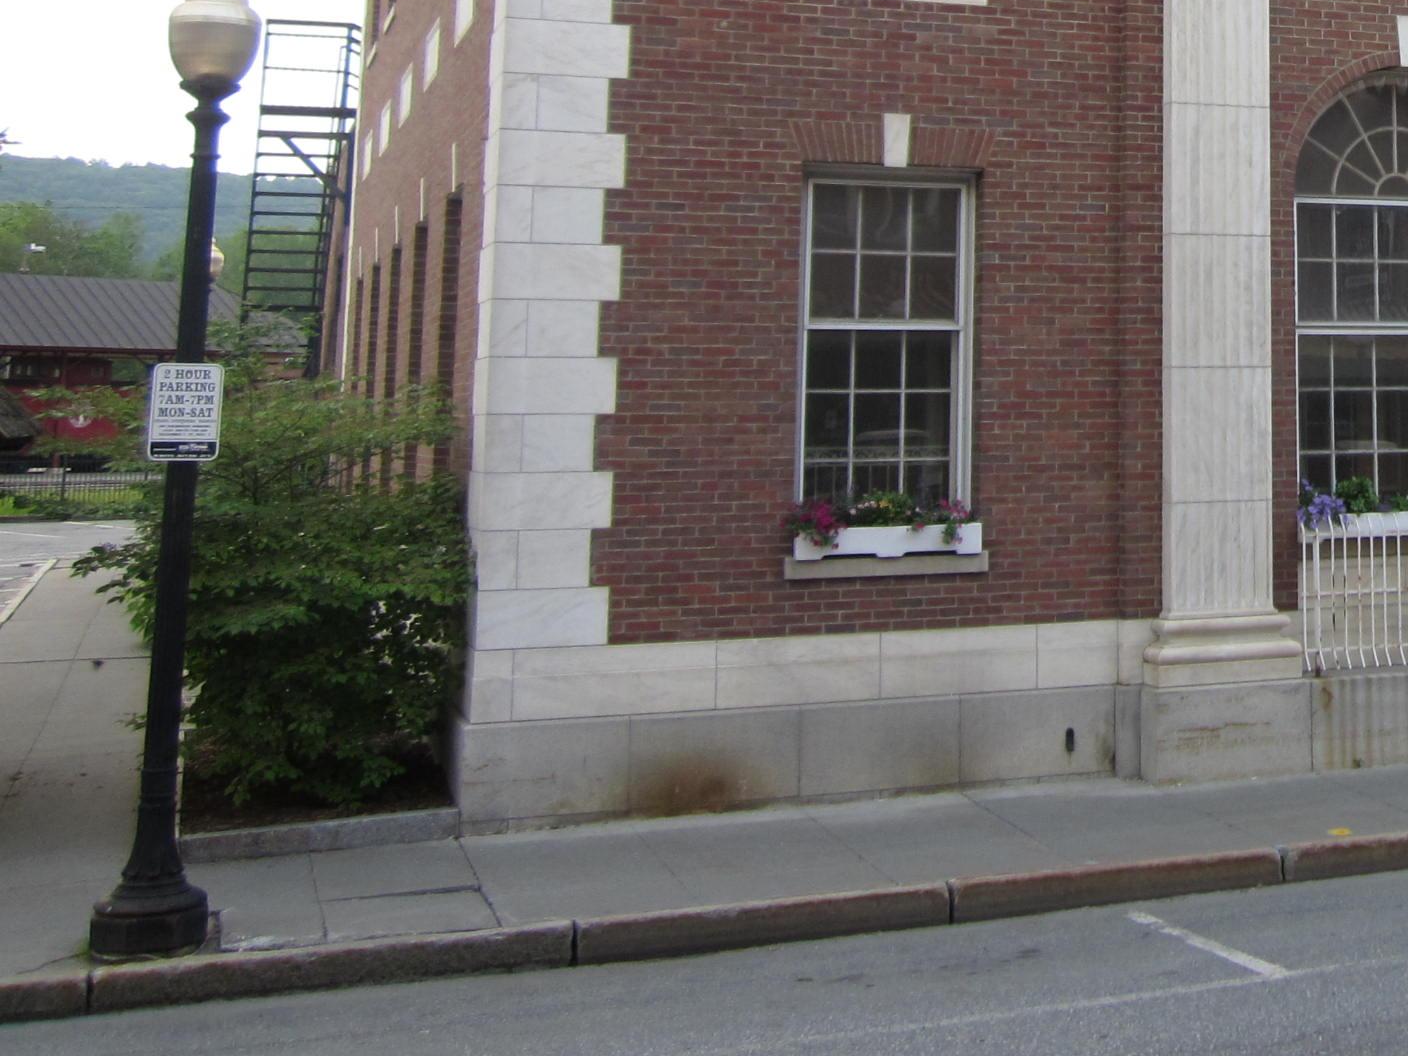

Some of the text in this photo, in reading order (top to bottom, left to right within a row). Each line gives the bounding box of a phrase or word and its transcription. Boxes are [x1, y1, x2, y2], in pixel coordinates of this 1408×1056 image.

[164, 369, 211, 380] 2 HOUR
[160, 381, 216, 392] PARKING
[159, 394, 215, 405] 7AM-7PM
[157, 407, 213, 418] MON-SAT
